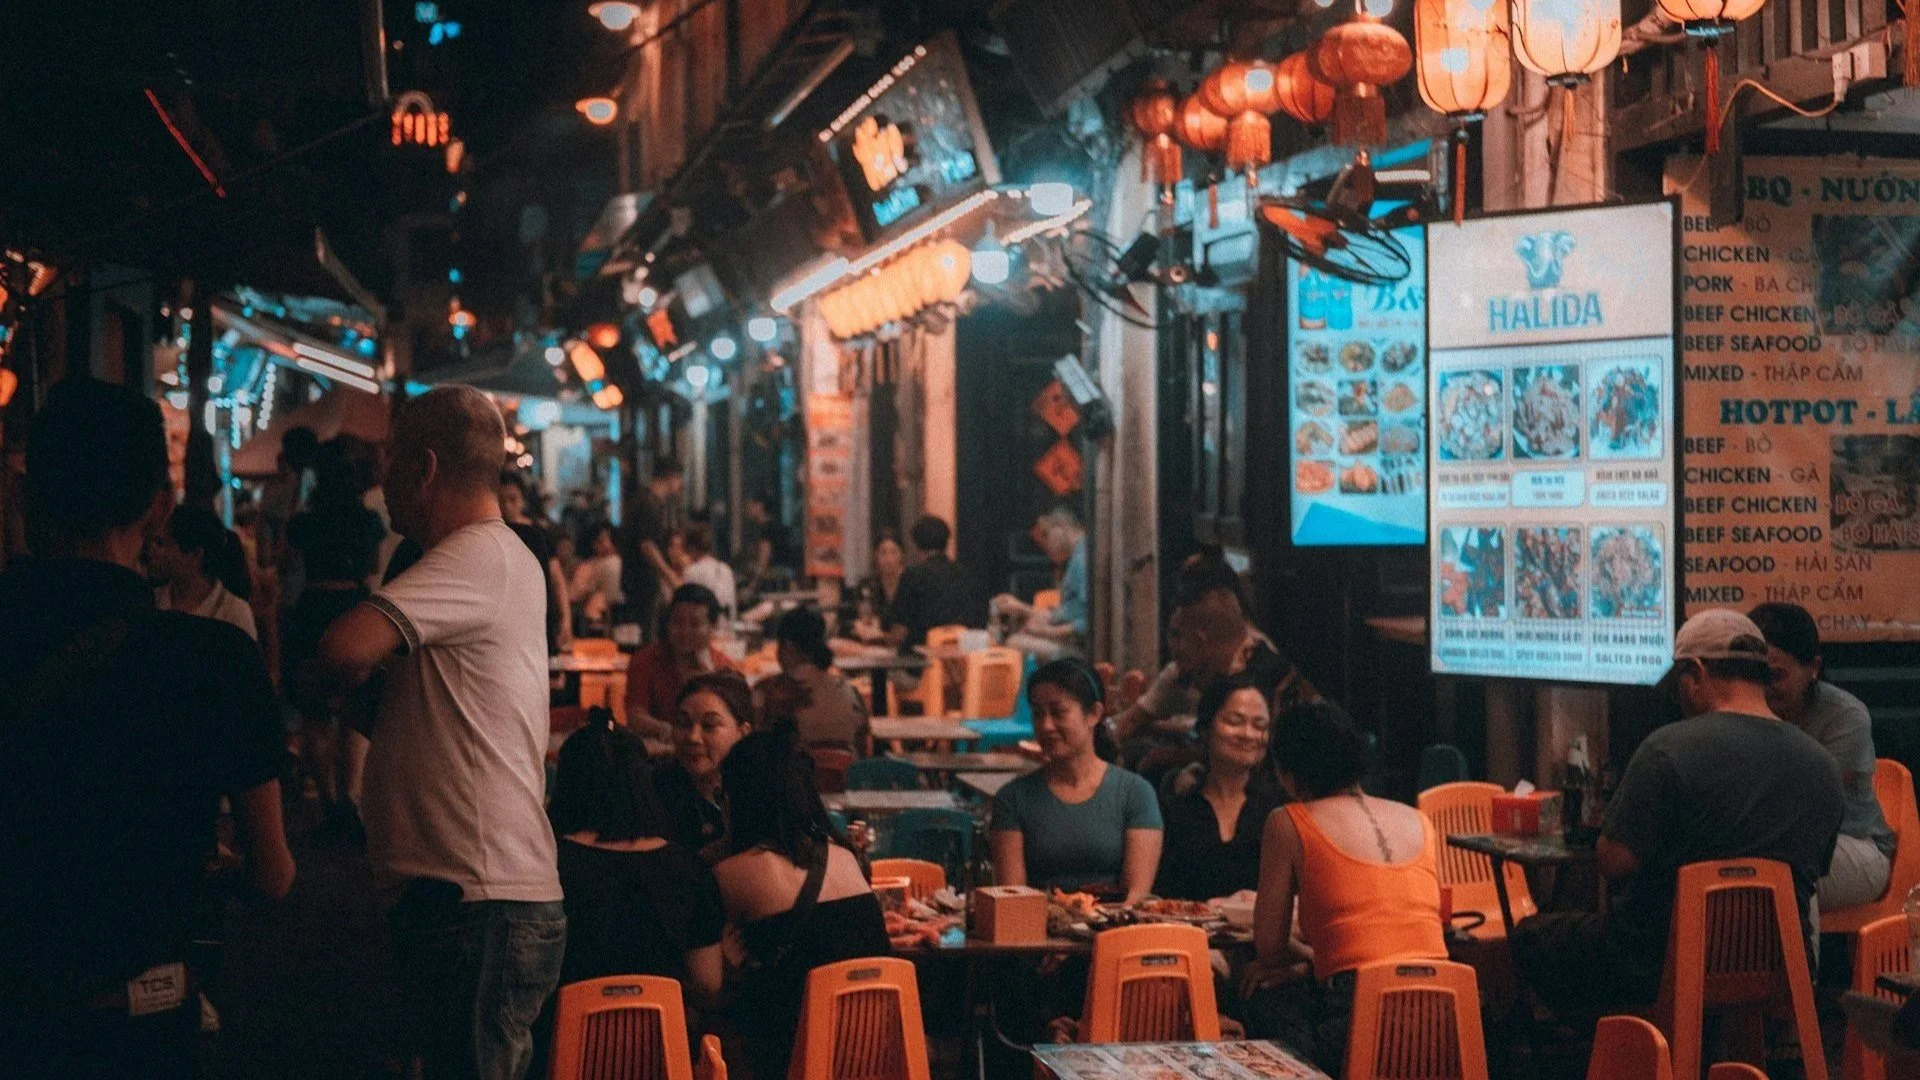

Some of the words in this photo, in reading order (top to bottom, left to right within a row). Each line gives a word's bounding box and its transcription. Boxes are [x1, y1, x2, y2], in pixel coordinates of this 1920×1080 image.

[1747, 176, 1792, 206] BQ
[1684, 216, 1720, 232] BEE
[1684, 246, 1770, 263] CHICKEN
[1684, 276, 1734, 292] PORK
[1755, 276, 1779, 292] BA
[1786, 276, 1814, 293] CH
[1489, 292, 1604, 332] HALIDA
[1684, 305, 1724, 322] BEEF
[1731, 305, 1816, 322] CHICKEN
[1684, 335, 1724, 352] BEEF
[1731, 335, 1822, 352] SEAFOOD
[1684, 365, 1744, 382] MIXED
[1720, 399, 1858, 424] HOTPOT
[1684, 438, 1725, 454] BEEF
[1746, 433, 1772, 454] BÒ
[1684, 467, 1771, 483] CHICKEN
[1791, 462, 1821, 483] GÀ
[1684, 497, 1725, 513] BEEF
[1732, 497, 1817, 513] CHICKEN
[1684, 526, 1725, 542] BEEF
[1732, 526, 1822, 543] SEAFOOD
[1685, 556, 1775, 573] SEAFOOD
[1795, 551, 1828, 572] HẢI
[1685, 586, 1744, 602] MIXED
[1595, 653, 1631, 665] SALTED
[1636, 654, 1662, 666] FROG
